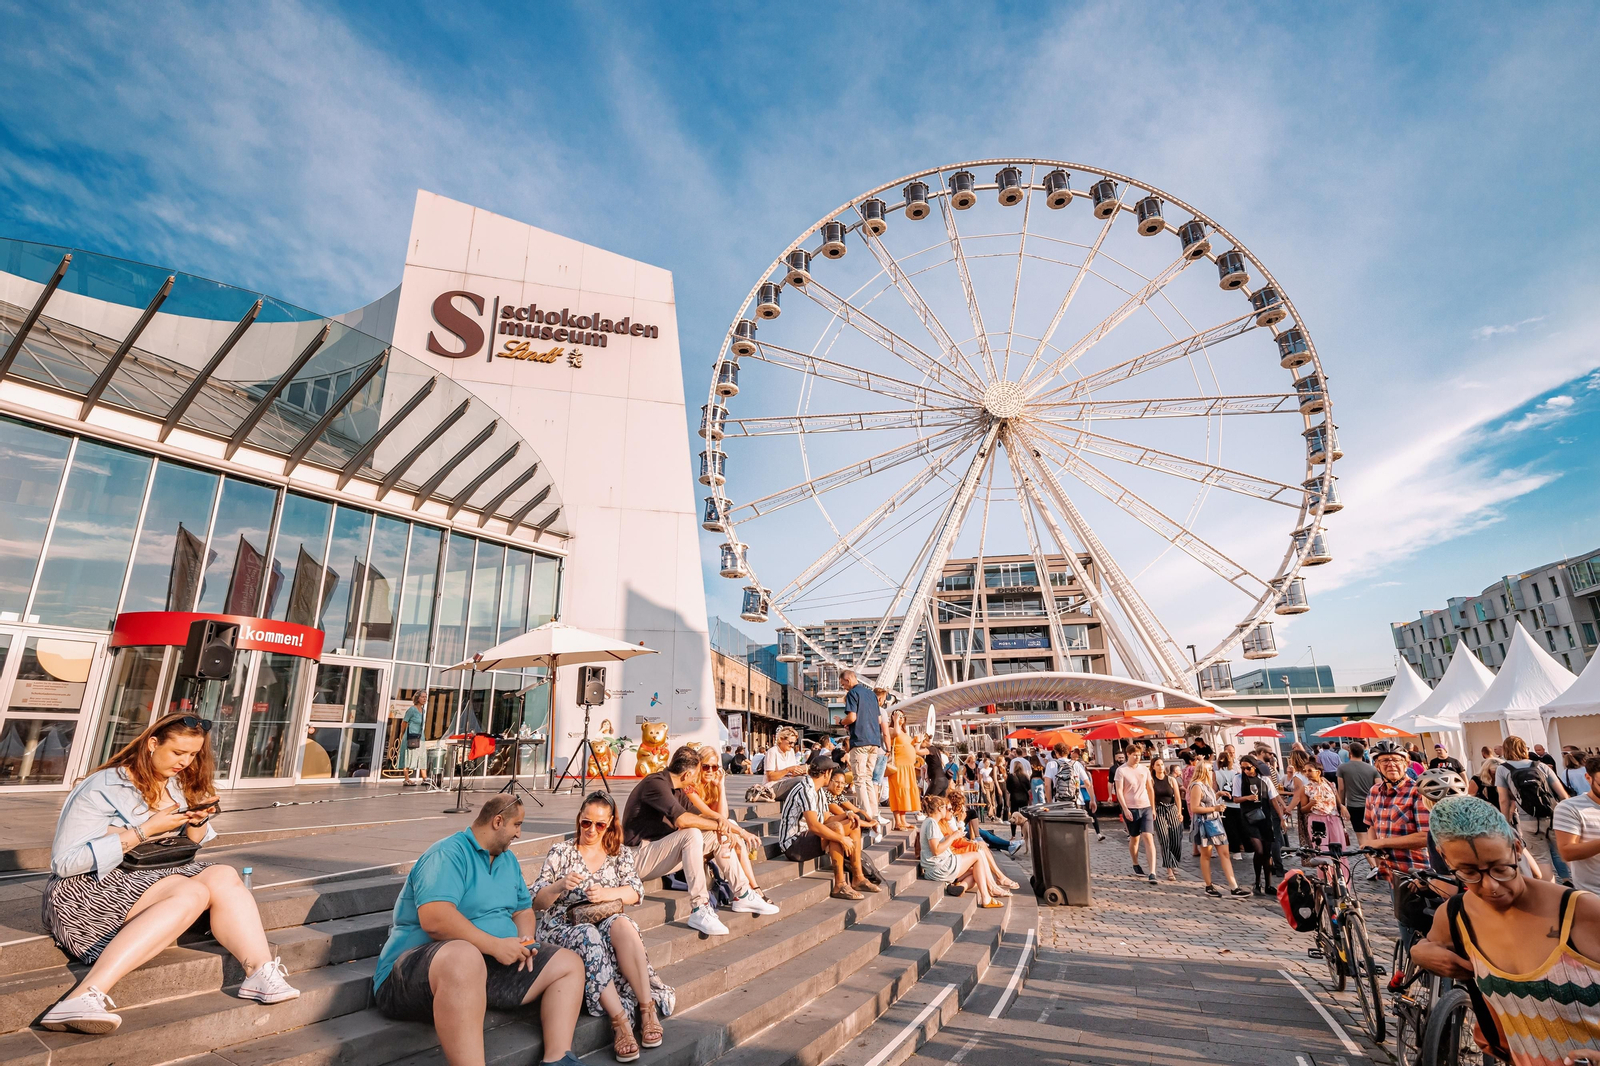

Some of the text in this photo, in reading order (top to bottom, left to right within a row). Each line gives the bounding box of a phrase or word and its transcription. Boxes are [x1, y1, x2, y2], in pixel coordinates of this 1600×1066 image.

[426, 290, 485, 359] S
[498, 320, 608, 348] museum
[501, 304, 659, 339] schokoladen
[498, 340, 564, 364] Lindt
[238, 624, 304, 647] lkommen!
